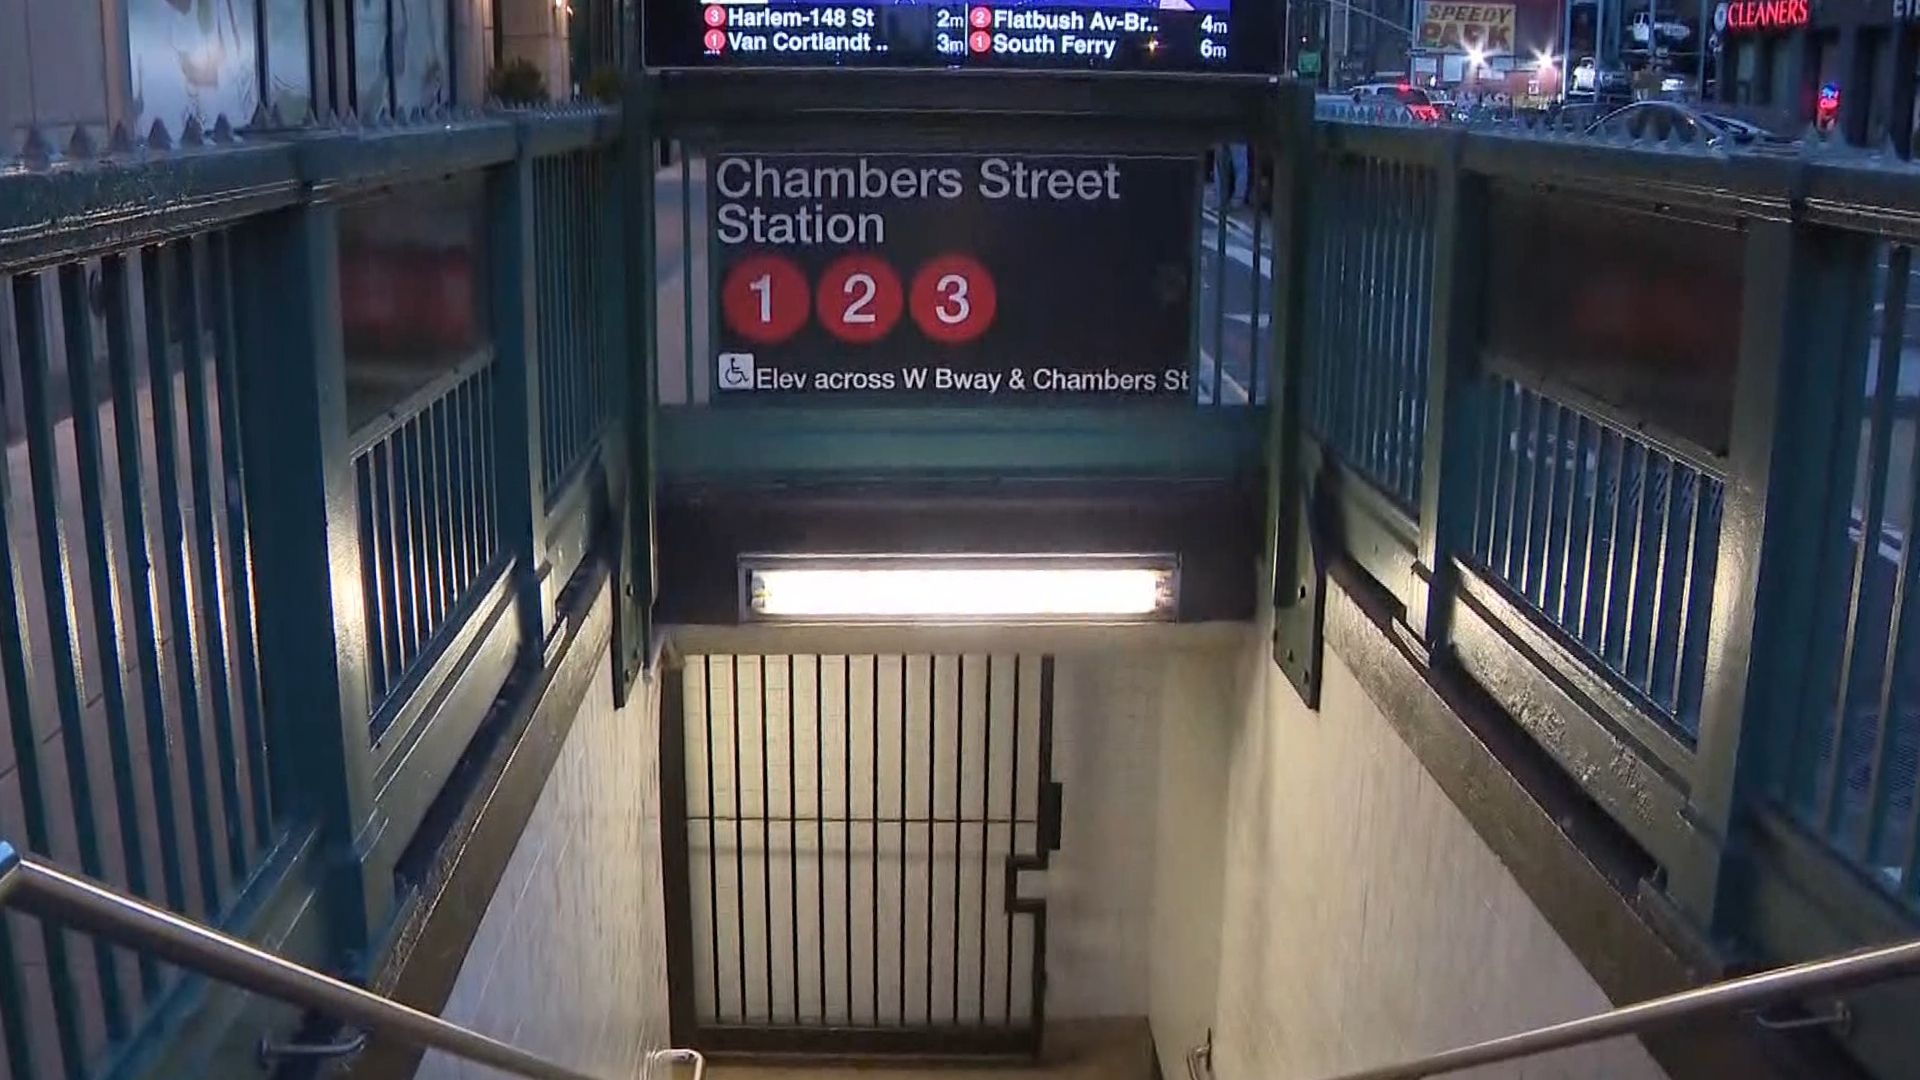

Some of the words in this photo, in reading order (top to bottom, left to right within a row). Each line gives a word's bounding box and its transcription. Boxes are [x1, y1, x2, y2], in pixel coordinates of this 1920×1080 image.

[729, 7, 846, 27] Harlem-148
[852, 8, 875, 27] St
[936, 9, 964, 28] 2m
[994, 9, 1084, 31] Flatbush
[1090, 11, 1158, 32] Av-Br..
[1201, 15, 1228, 34] 4m
[1429, 5, 1511, 22] SPEEDY
[1728, 0, 1808, 26] CLEANERS
[728, 31, 767, 51] Van
[773, 32, 871, 51] Cortlandt
[936, 33, 964, 53] 3m
[993, 33, 1055, 54] South
[1061, 35, 1116, 59] Ferry
[1201, 39, 1227, 58] 6m
[717, 157, 963, 198] Chambers
[979, 159, 1120, 200] Street
[717, 203, 884, 243] Station
[750, 274, 771, 322] 1
[843, 274, 876, 323] 2
[935, 274, 970, 324] 3
[756, 368, 807, 389] Elev
[815, 372, 896, 390] across
[903, 368, 929, 389] W
[936, 368, 1002, 394] Bway
[1009, 369, 1026, 390] &
[1033, 369, 1157, 390] Chambers
[1164, 370, 1189, 390] St
